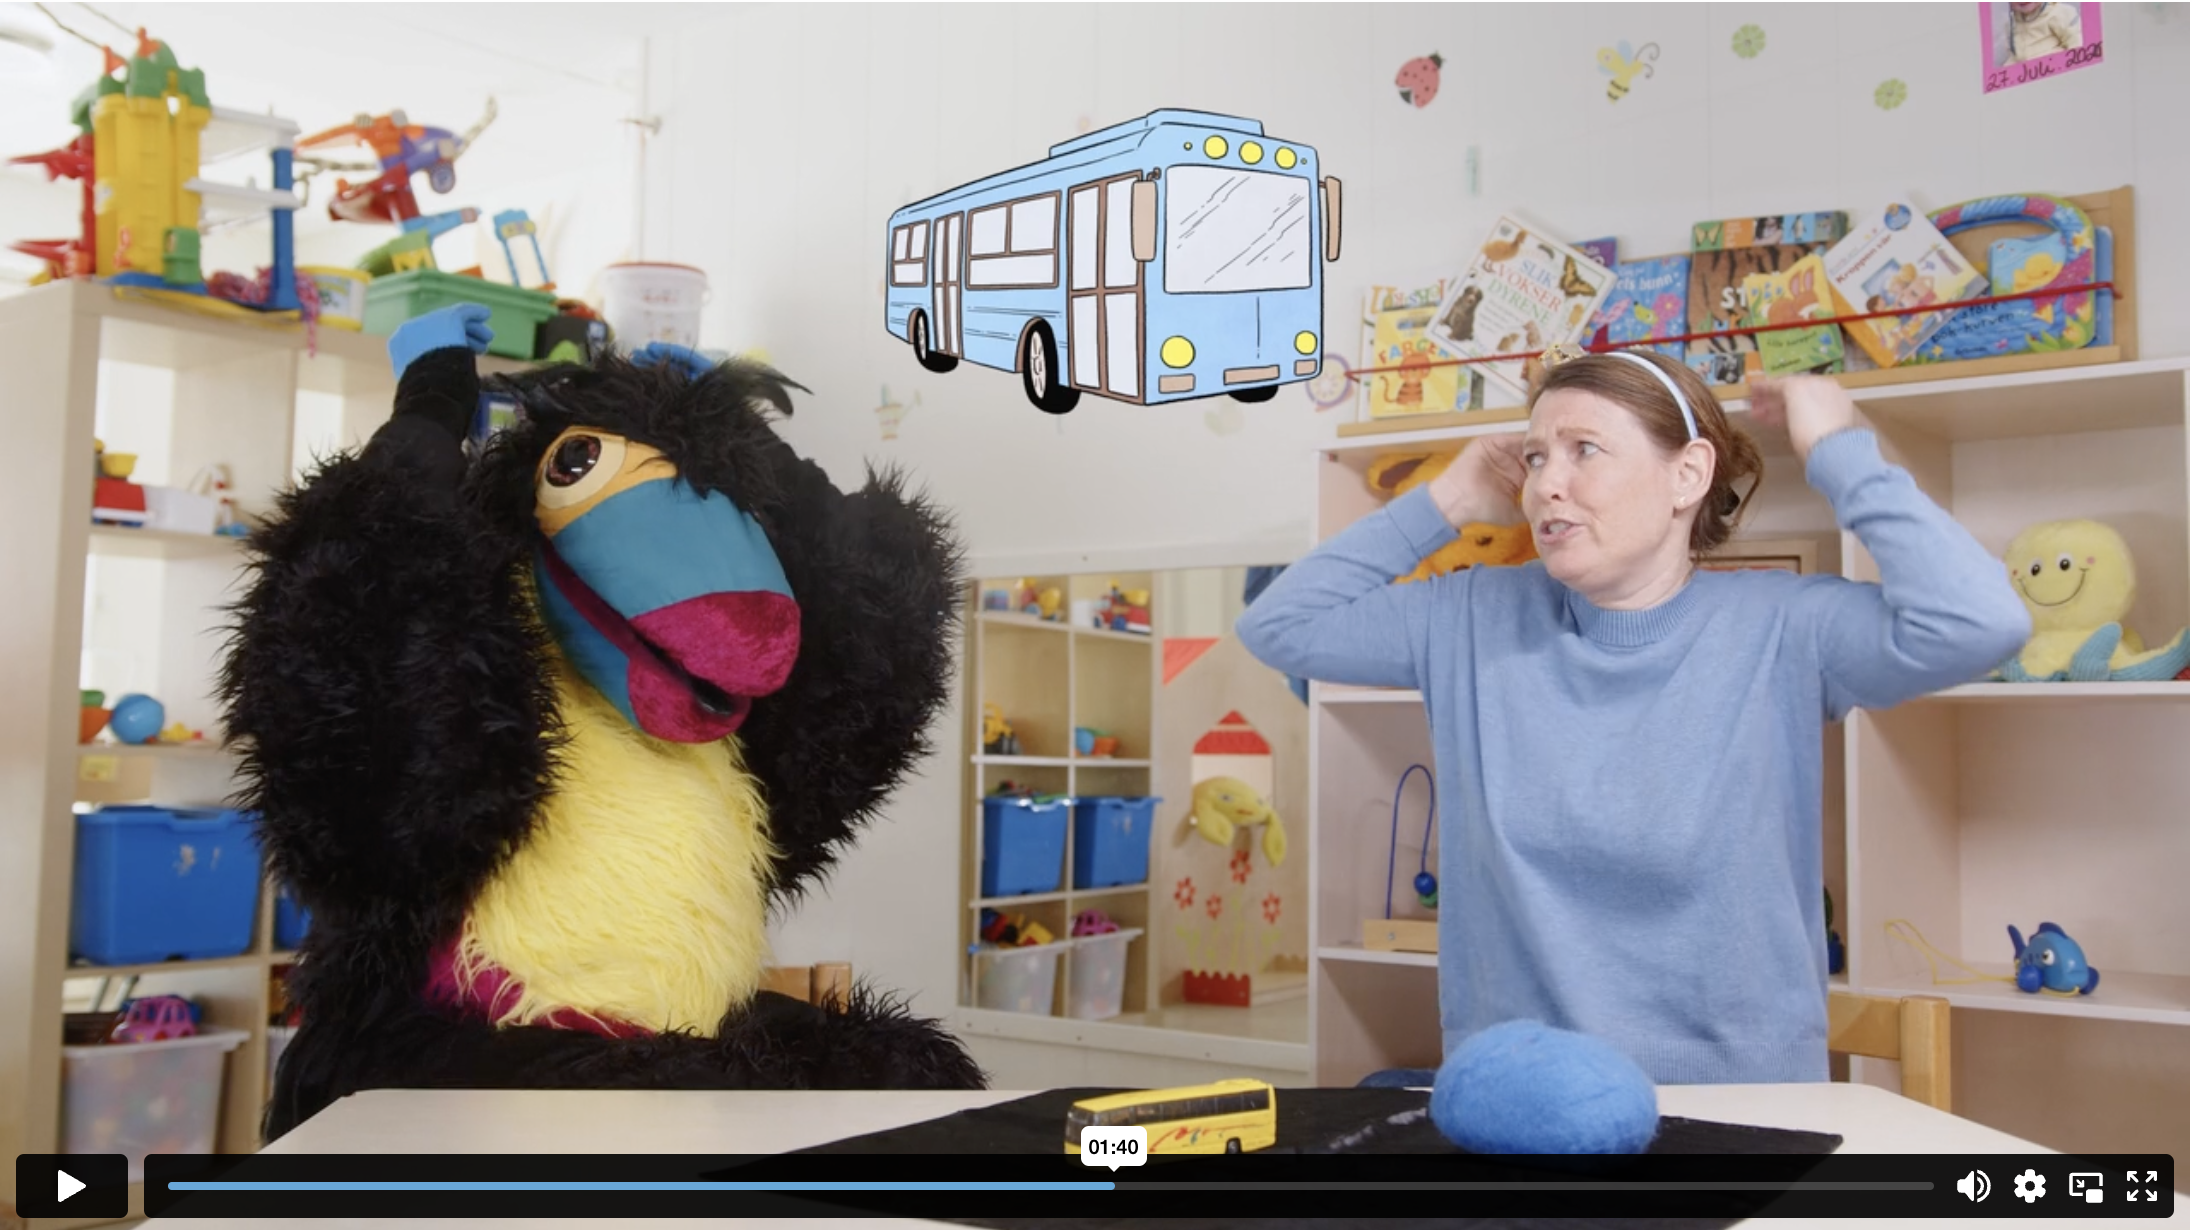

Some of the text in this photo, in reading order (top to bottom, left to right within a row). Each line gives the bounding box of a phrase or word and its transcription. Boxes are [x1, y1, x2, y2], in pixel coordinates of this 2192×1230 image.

[1521, 259, 1556, 289] SLIK
[1639, 272, 1674, 291] bunn
[1836, 248, 1877, 283] Kroppen
[1487, 277, 1552, 324] DYRENE
[1498, 262, 1562, 313] VOKSER
